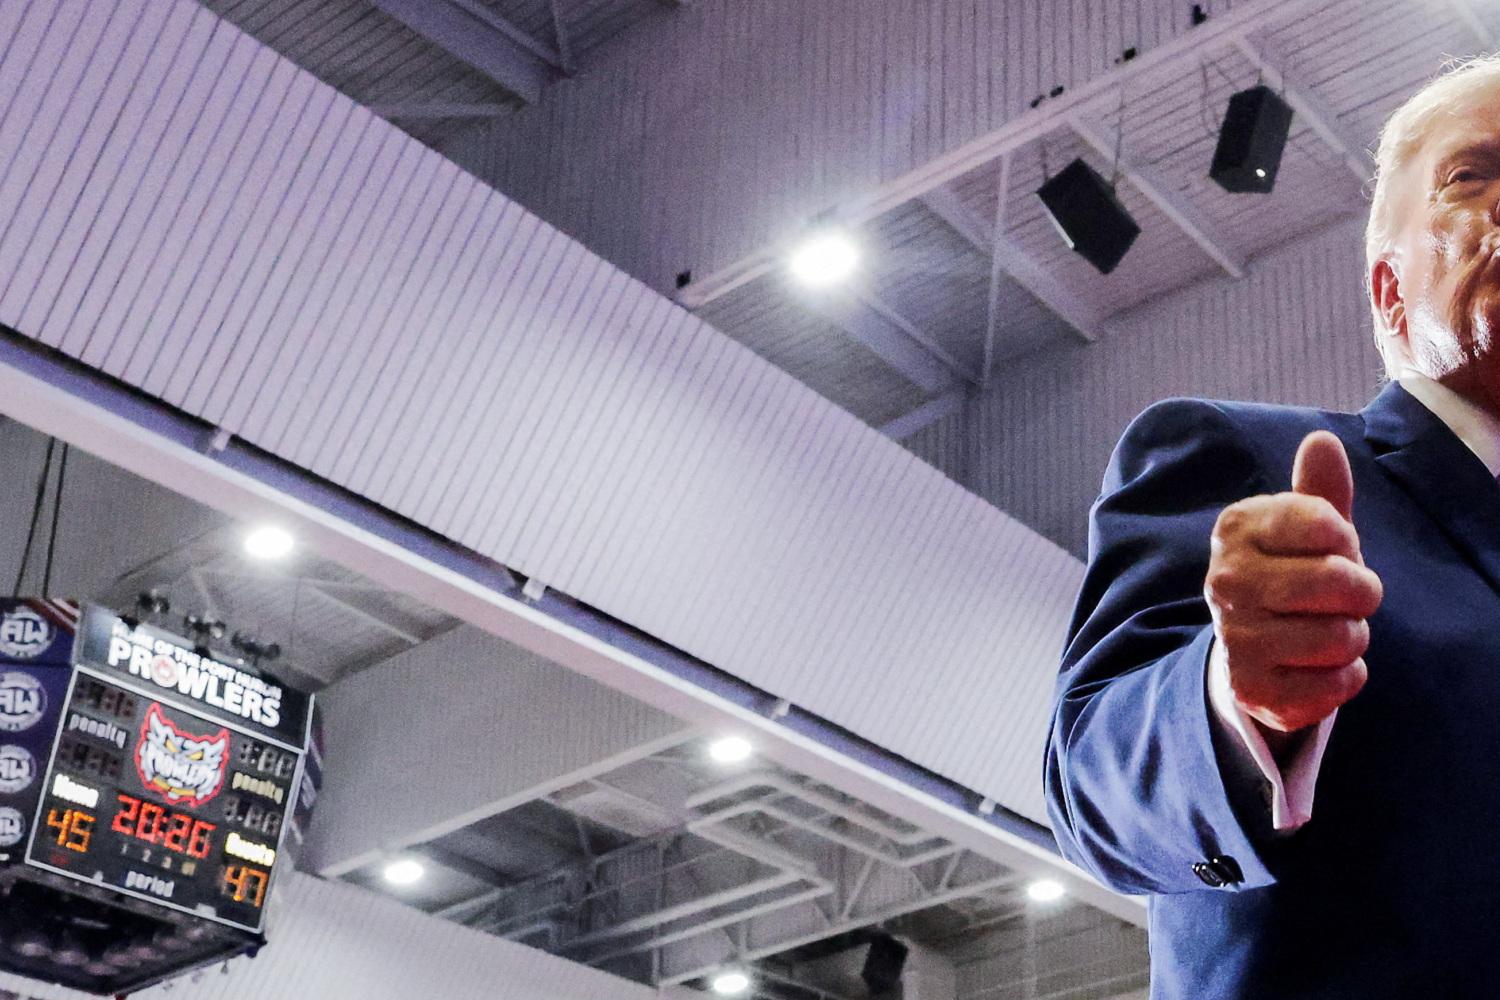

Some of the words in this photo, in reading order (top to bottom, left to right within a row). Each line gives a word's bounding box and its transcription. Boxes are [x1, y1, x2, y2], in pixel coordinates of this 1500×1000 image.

[107, 637, 281, 728] PROWLERS
[47, 809, 97, 853] 45
[223, 866, 269, 908] 47
